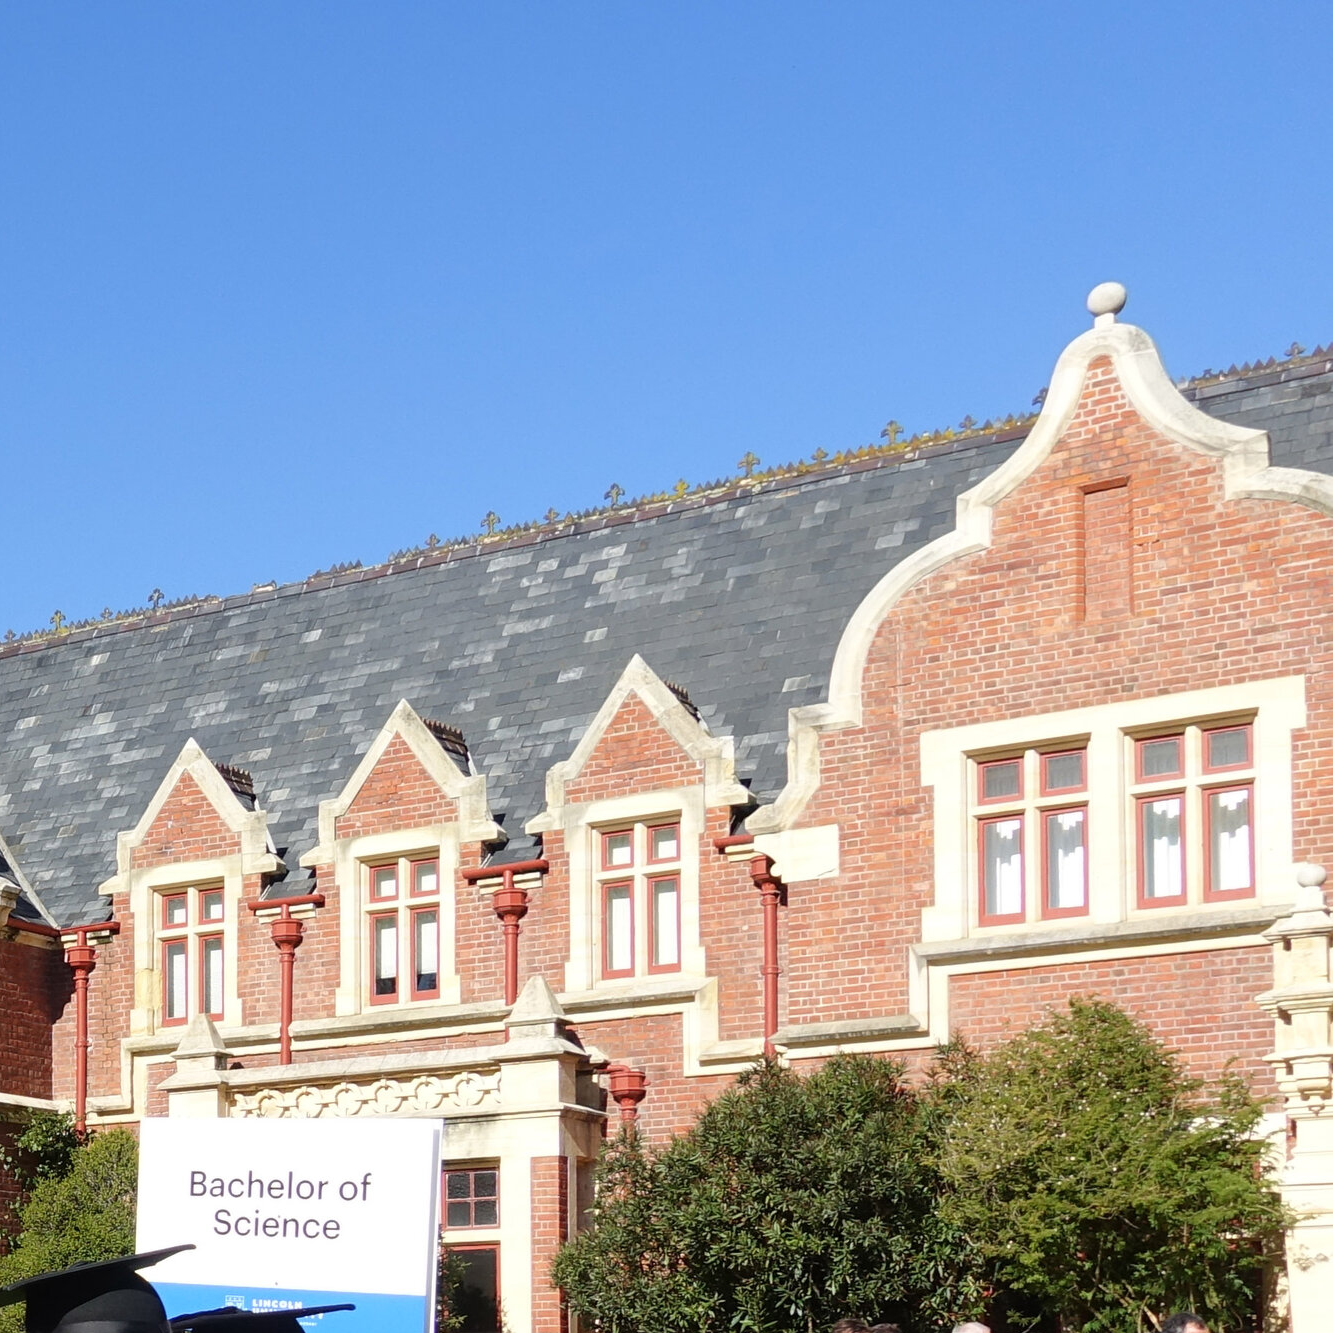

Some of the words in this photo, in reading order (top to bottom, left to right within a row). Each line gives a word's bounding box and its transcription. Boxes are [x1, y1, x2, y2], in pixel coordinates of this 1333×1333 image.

[190, 1170, 328, 1200] Bachelor
[339, 1172, 372, 1201] of
[214, 1209, 340, 1239] Science
[252, 1299, 303, 1309] LINCOLN
